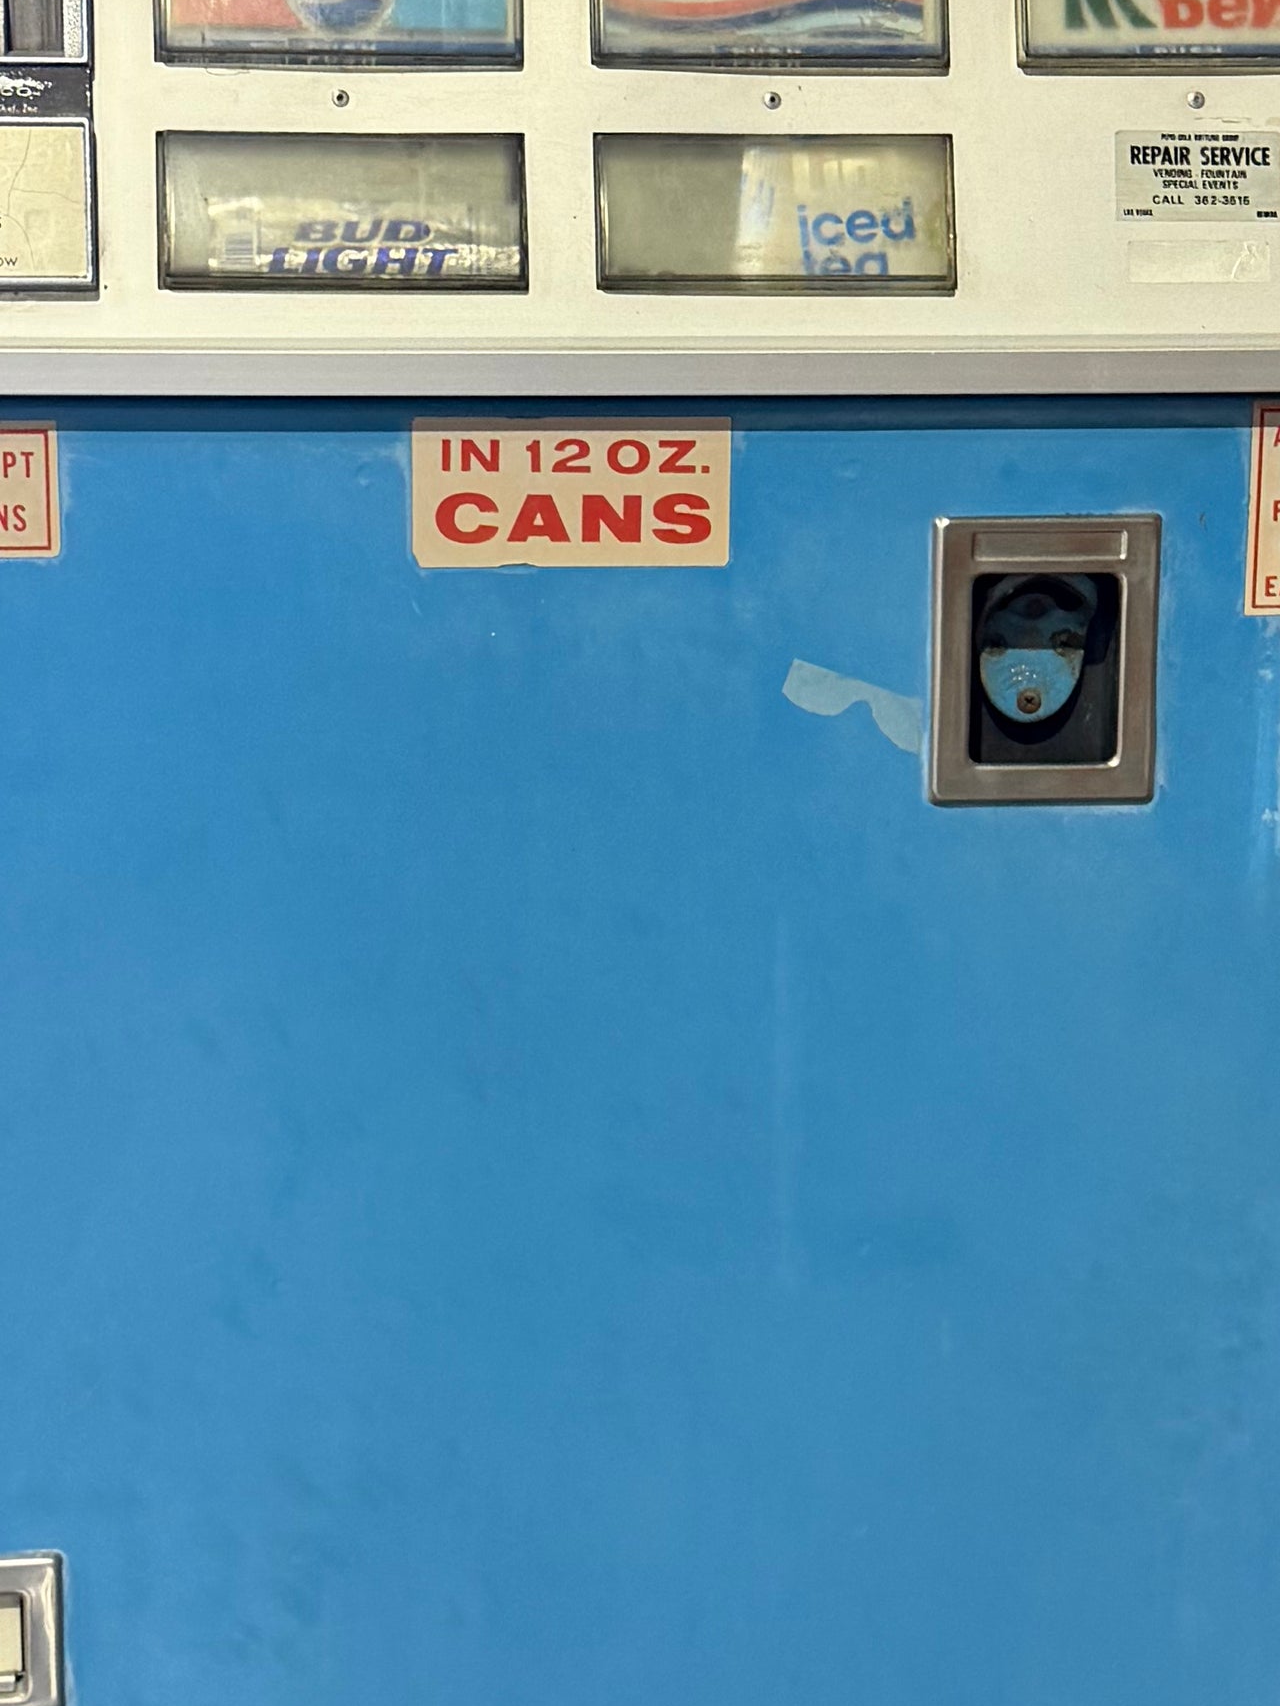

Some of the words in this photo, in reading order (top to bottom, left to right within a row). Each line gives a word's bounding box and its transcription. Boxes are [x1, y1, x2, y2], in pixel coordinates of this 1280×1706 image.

[1130, 145, 1191, 166] REPAIR
[1200, 146, 1271, 166] SERVICE
[1153, 168, 1193, 179] VENDING
[1201, 169, 1247, 180] FOUNTAIN
[1162, 179, 1199, 190] SPECIAL
[1202, 180, 1239, 190] EVENTS
[1152, 194, 1184, 205] CALL
[293, 218, 434, 244] BUD
[796, 195, 917, 248] iced
[268, 246, 459, 276] LIGHT
[441, 438, 500, 473] IN
[434, 491, 712, 545] CANS
